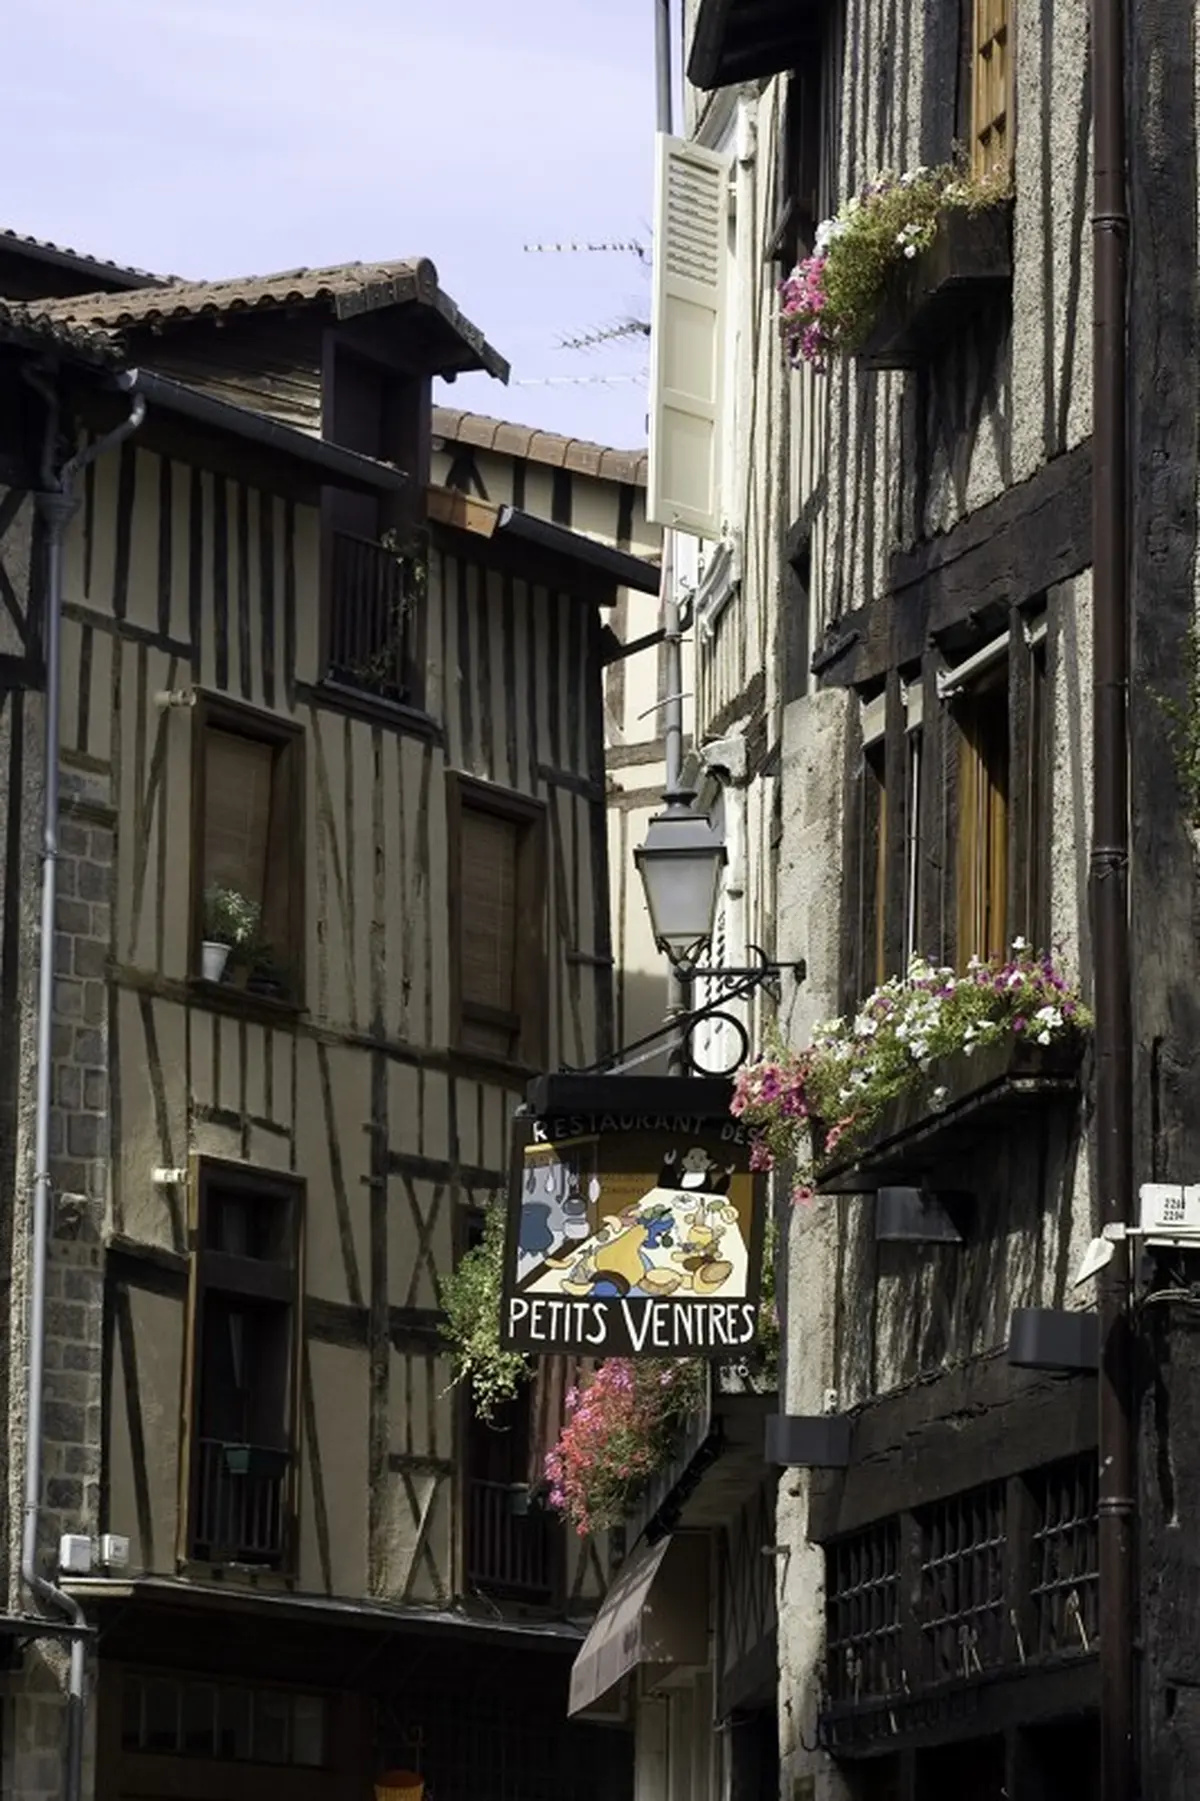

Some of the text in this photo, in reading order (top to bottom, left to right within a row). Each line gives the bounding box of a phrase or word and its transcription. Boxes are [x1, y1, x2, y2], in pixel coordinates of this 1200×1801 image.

[533, 1114, 761, 1146] RESTAURANT DES
[509, 1299, 756, 1351] PETITS VENTRES
